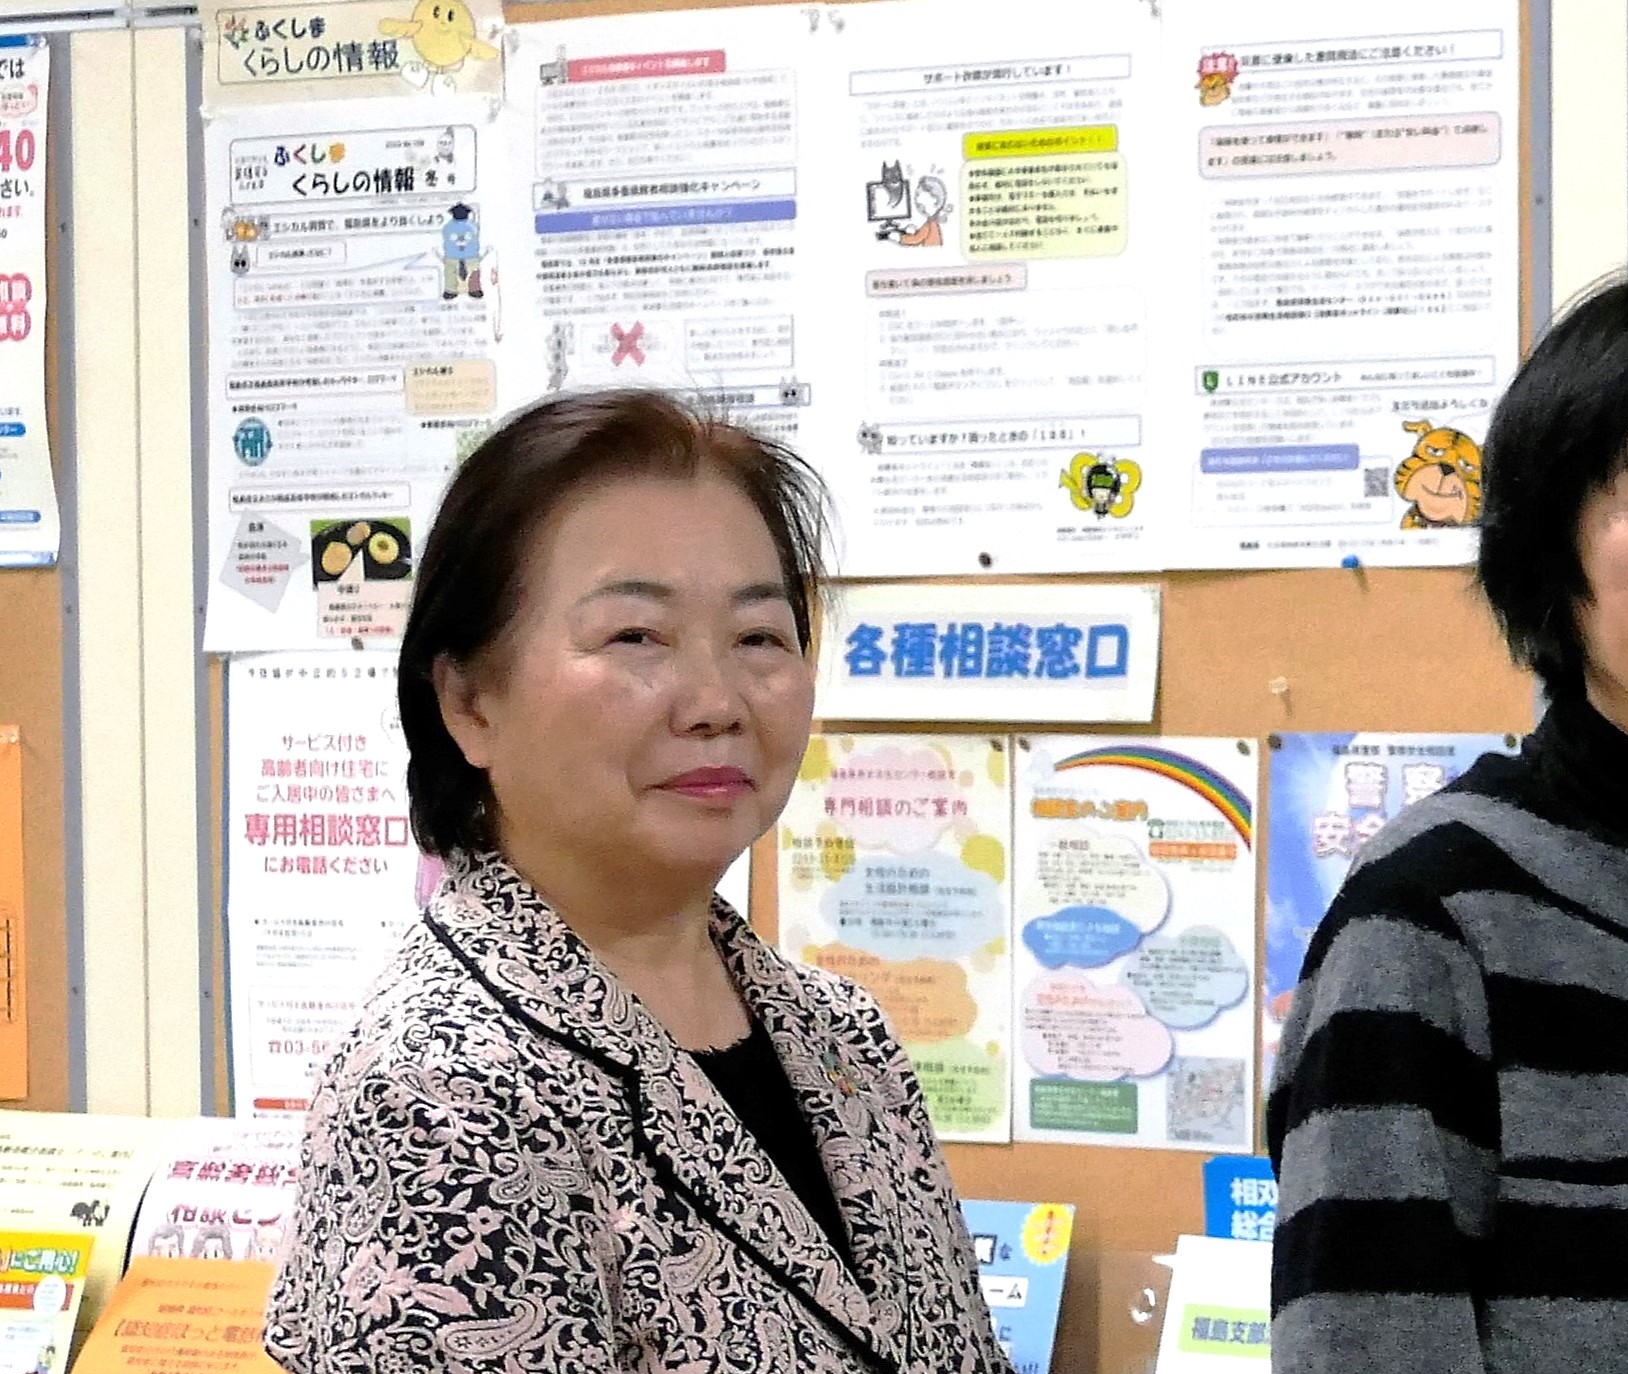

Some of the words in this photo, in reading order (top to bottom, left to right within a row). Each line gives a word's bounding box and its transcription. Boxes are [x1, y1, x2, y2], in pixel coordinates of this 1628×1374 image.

[255, 16, 325, 41] ふくしま
[243, 38, 400, 76] くらしの情報
[275, 142, 346, 166] ふくしま
[292, 166, 415, 196] くらしの情報
[845, 623, 1131, 680] 各種相談窓口
[282, 734, 367, 751] サービス付き
[261, 760, 388, 778] 高齢者向け住宅に
[256, 783, 395, 804] ご入居中の皆さまへ
[823, 798, 968, 817] 専門相談のご案内
[244, 814, 409, 847] 専用相談窓口
[264, 857, 388, 875] にお電話ください
